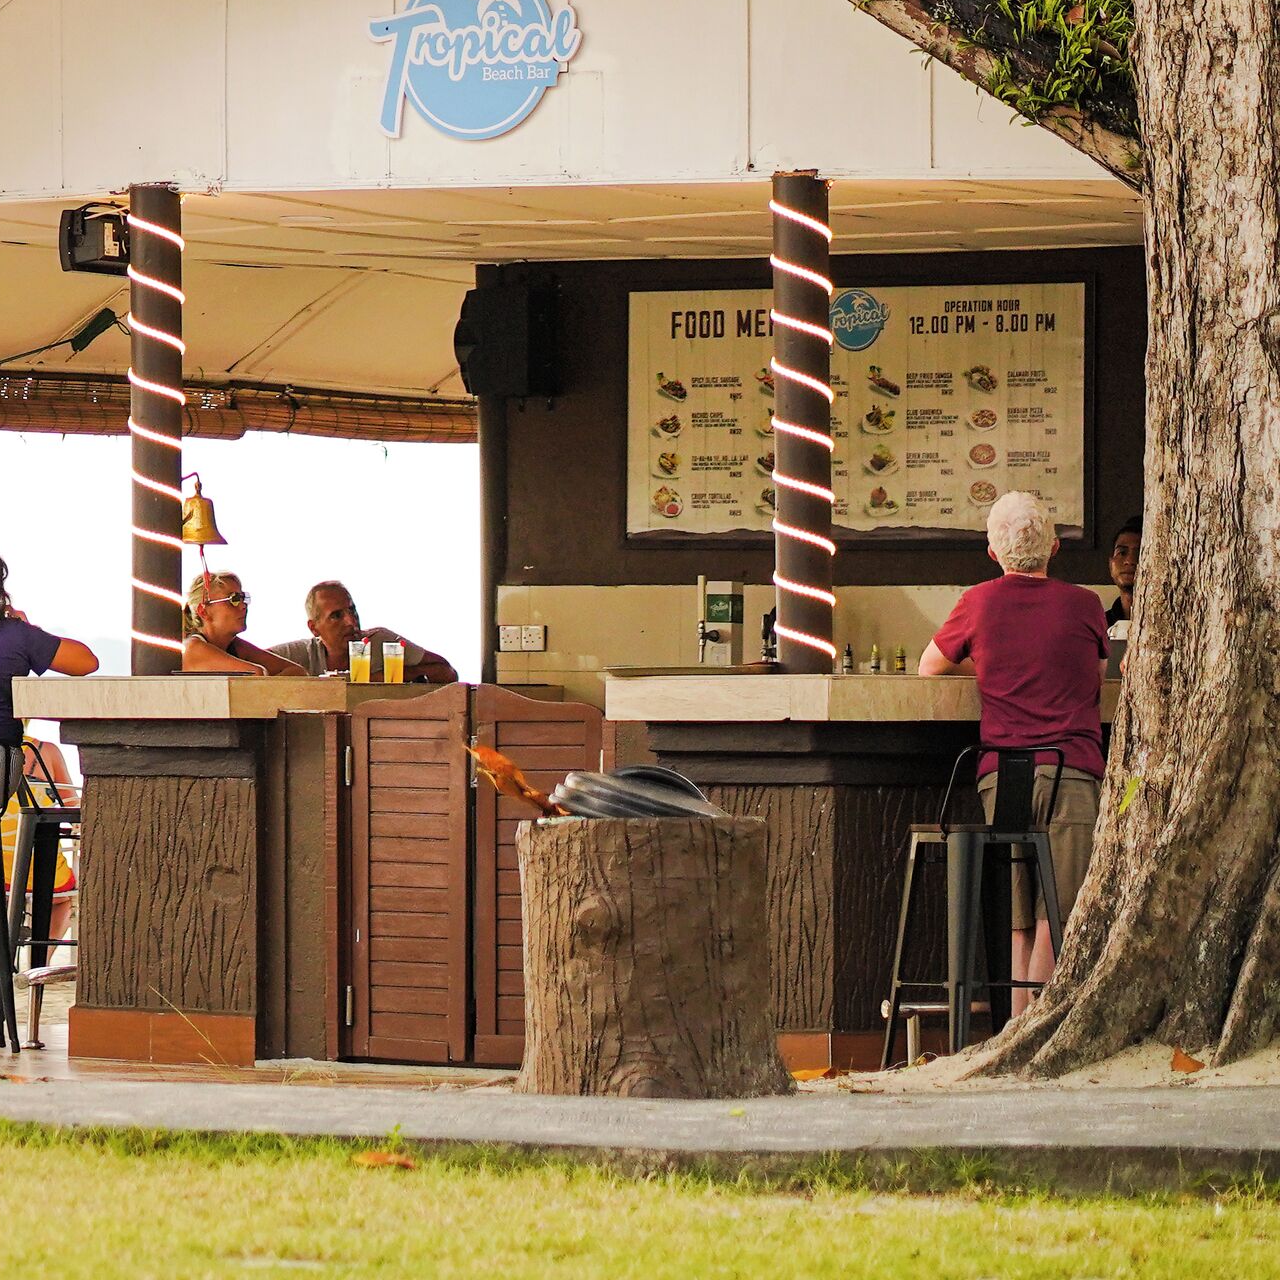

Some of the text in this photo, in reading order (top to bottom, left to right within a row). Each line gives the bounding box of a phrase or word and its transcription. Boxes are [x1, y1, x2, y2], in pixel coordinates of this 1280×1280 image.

[369, 4, 583, 138] Tropical
[482, 65, 551, 81] Beach Bar
[944, 299, 1021, 313] OPERATION HOUR
[671, 309, 774, 339] FOOD ME
[909, 315, 948, 335] 12.00
[956, 315, 975, 333] PM
[996, 314, 1028, 333] 8.00
[1035, 313, 1056, 332] PM
